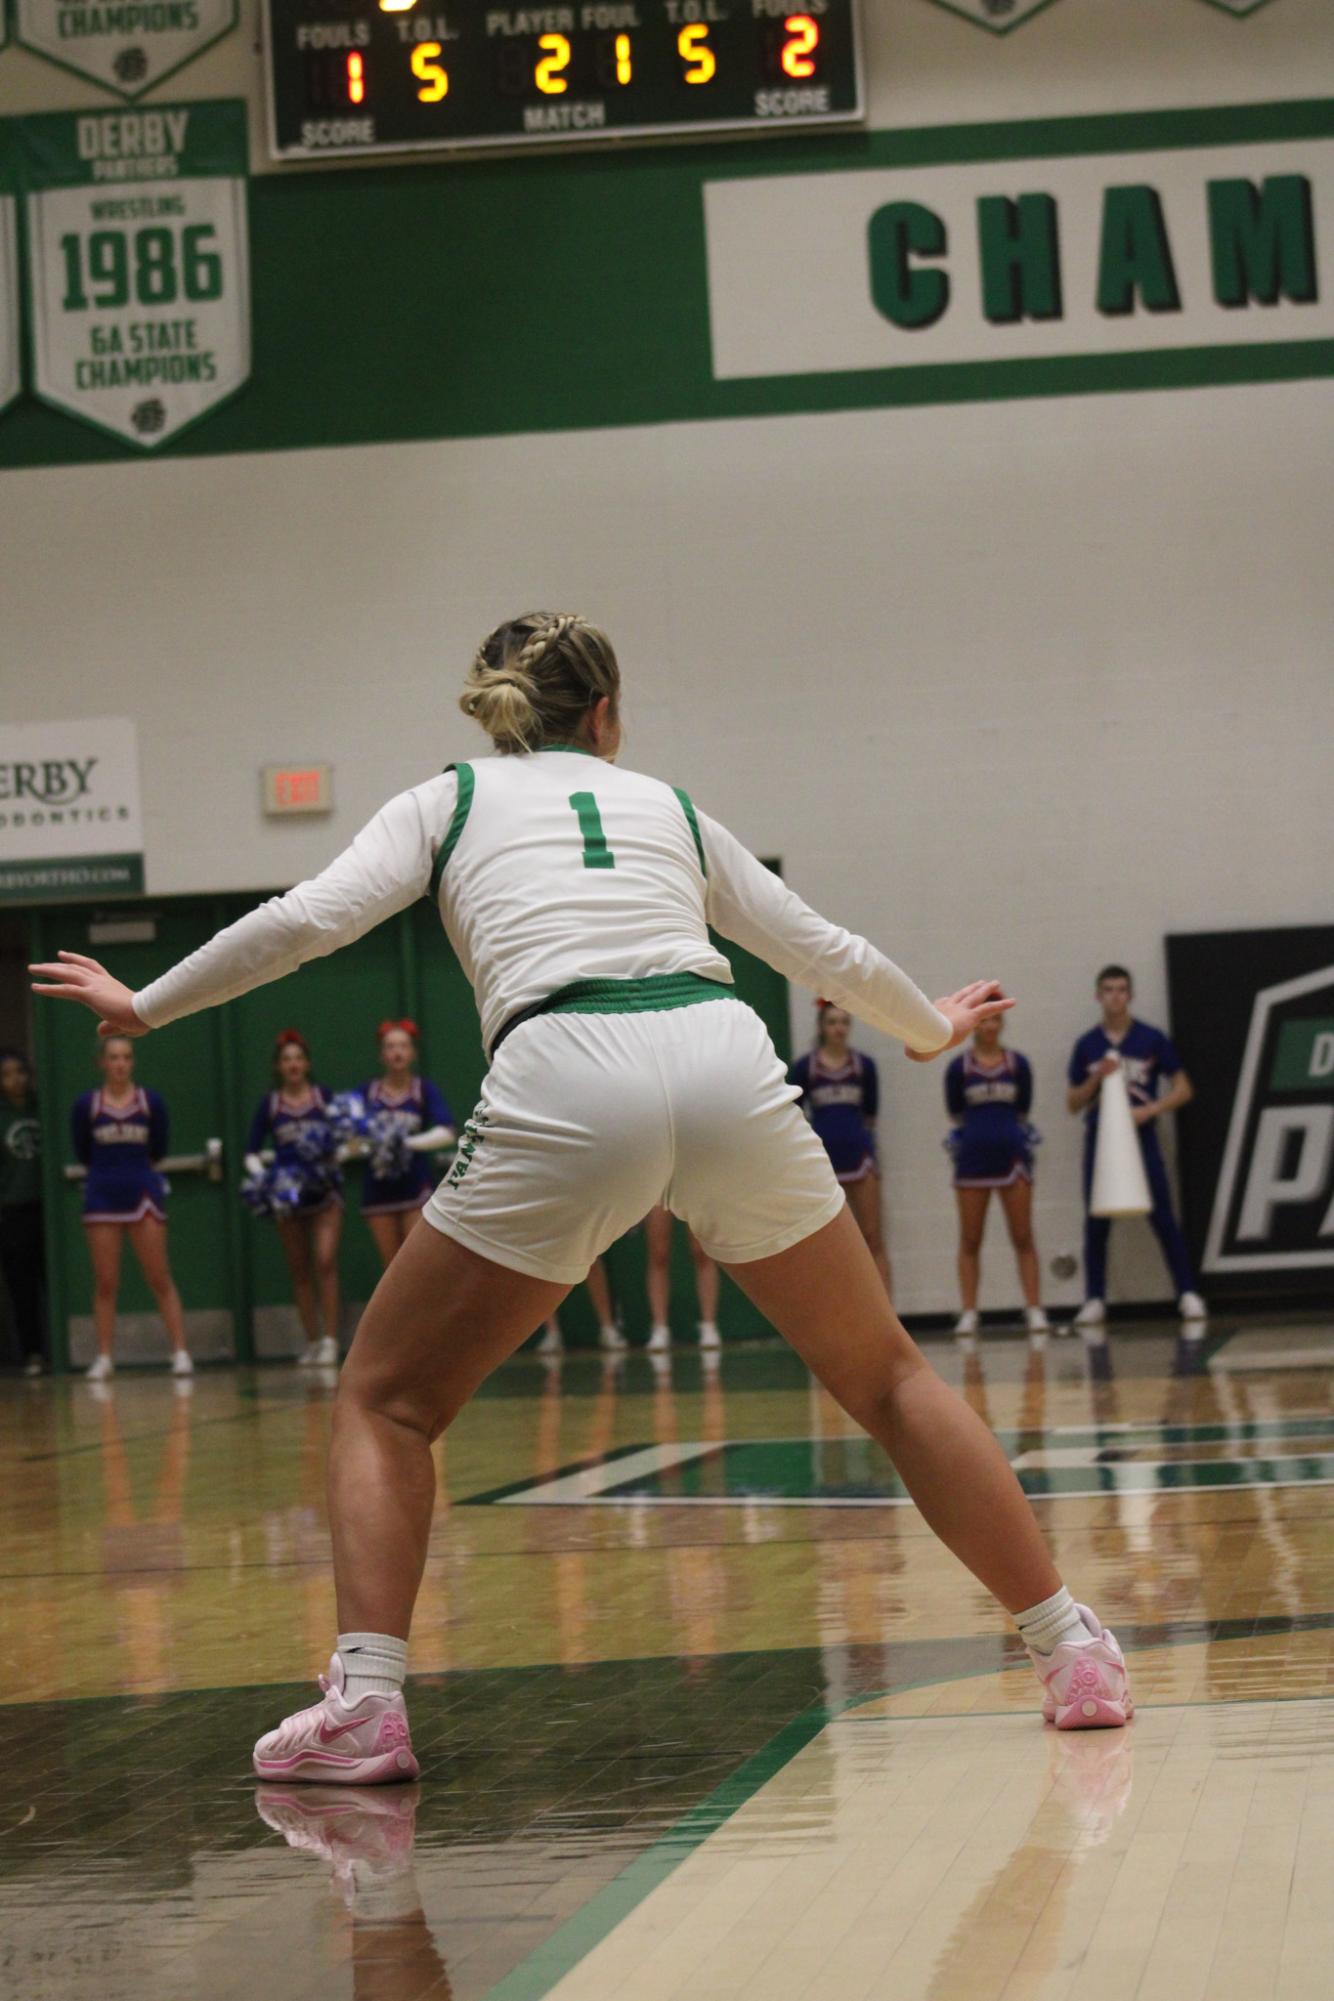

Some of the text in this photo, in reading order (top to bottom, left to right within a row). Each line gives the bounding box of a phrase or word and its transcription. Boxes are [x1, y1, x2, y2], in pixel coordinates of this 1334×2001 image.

[58, 3, 199, 38] CHAMPIONS
[486, 4, 640, 36] PLAYER FOUL
[752, 0, 828, 17] FOULS
[296, 20, 370, 50] FOULS
[678, 23, 716, 84] 5
[782, 13, 818, 77] 2
[347, 51, 364, 104] 1
[410, 41, 449, 103] 5
[535, 33, 571, 94] 2
[615, 34, 632, 85] 1
[522, 101, 606, 131] MATCH
[754, 88, 829, 117] SCORE
[77, 111, 188, 159] DERBY
[301, 117, 374, 148] SCORE
[61, 223, 223, 313] 1986
[867, 173, 1317, 330] CHAM
[129, 319, 197, 352] STATE
[75, 351, 218, 391] CHAMPIONS
[568, 791, 616, 869] 1
